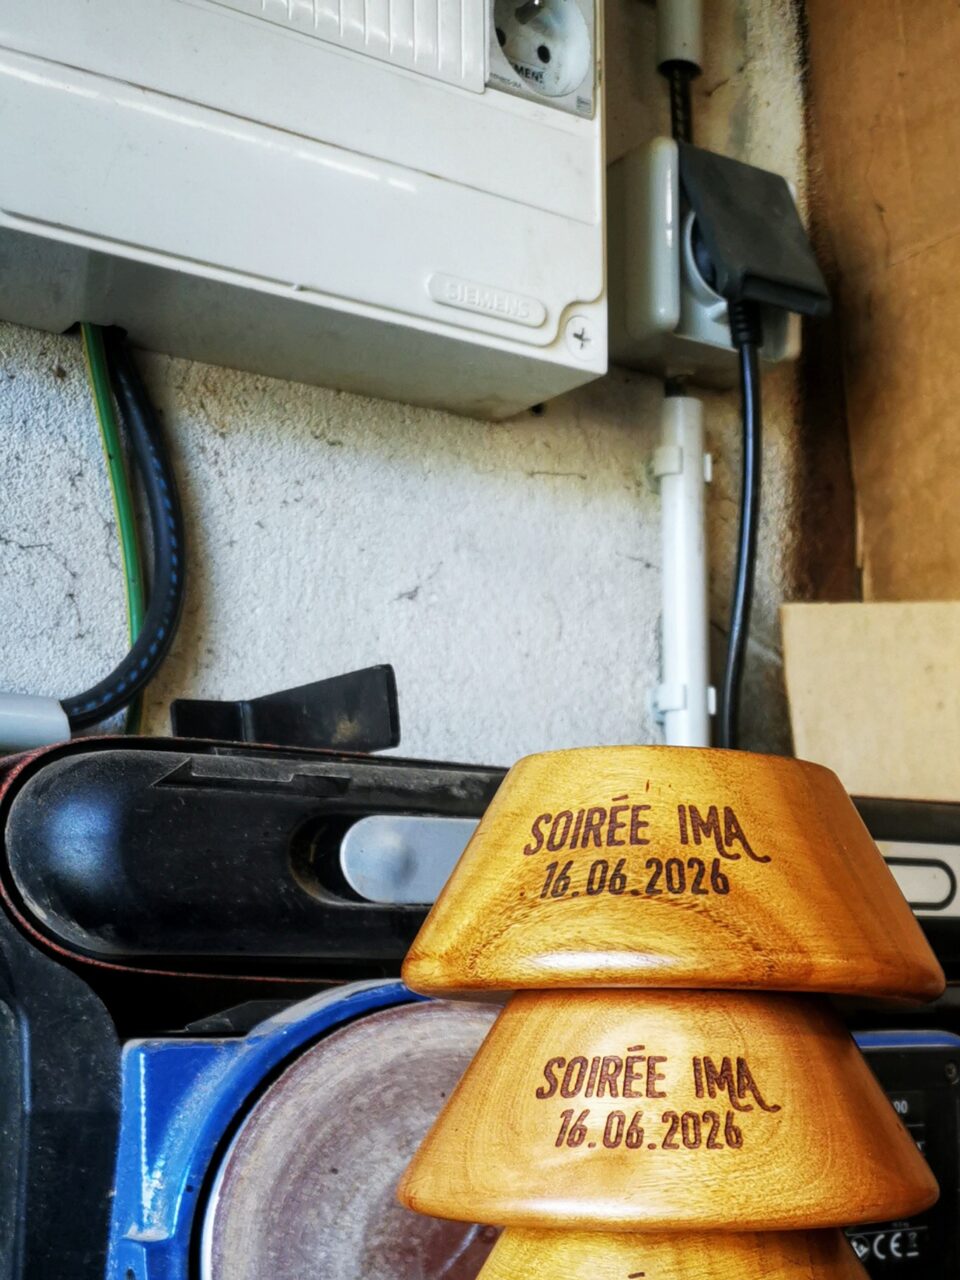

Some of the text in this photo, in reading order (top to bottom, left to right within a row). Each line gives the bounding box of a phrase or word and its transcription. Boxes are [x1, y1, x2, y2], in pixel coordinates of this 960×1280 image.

[446, 282, 530, 318] SIEMENS
[524, 795, 771, 863] SOIRÉE IMA
[540, 857, 729, 898] 16.06.2026
[536, 1045, 781, 1112] SOIRÉE IMA
[555, 1109, 743, 1150] 16.06.2026
